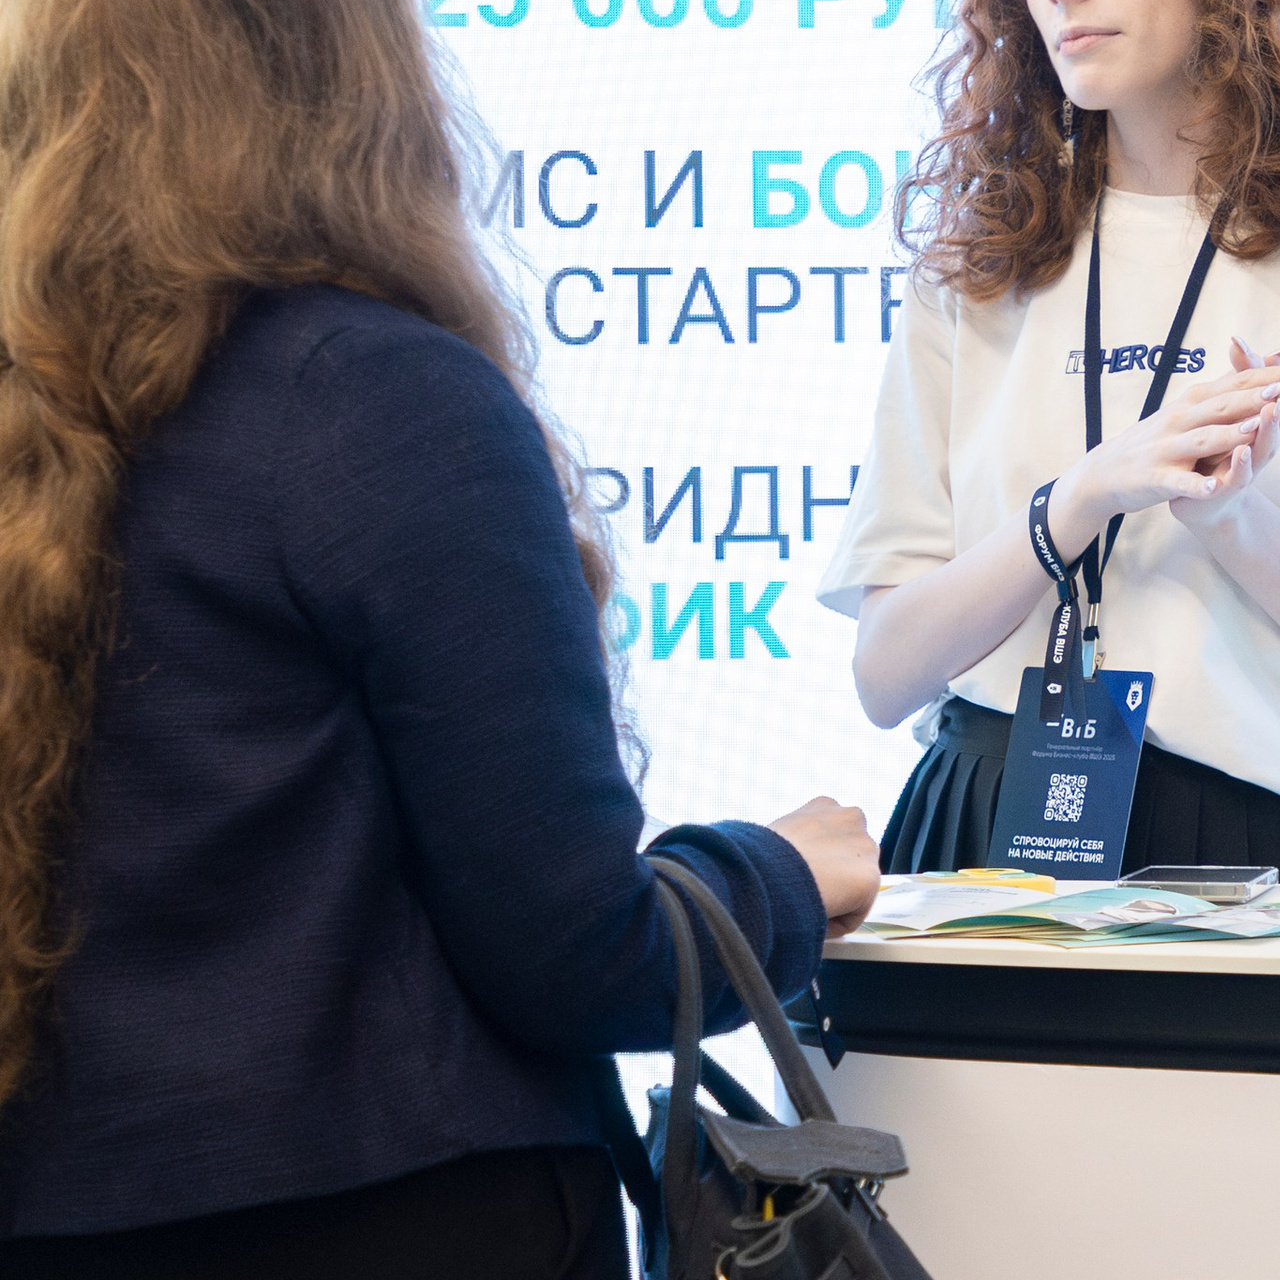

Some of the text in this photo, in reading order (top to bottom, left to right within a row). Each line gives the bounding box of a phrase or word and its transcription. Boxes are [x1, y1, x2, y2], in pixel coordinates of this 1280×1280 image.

[643, 149, 706, 228] И
[1035, 524, 1054, 564] ФОРУМ
[1053, 637, 1067, 664] ВШЭ
[1008, 847, 1105, 864] НА НОВЫЕ ДЕЙСТВИЯ!
[1013, 835, 1104, 850] СПРОВОЦИРУЙ СЕБЯ
